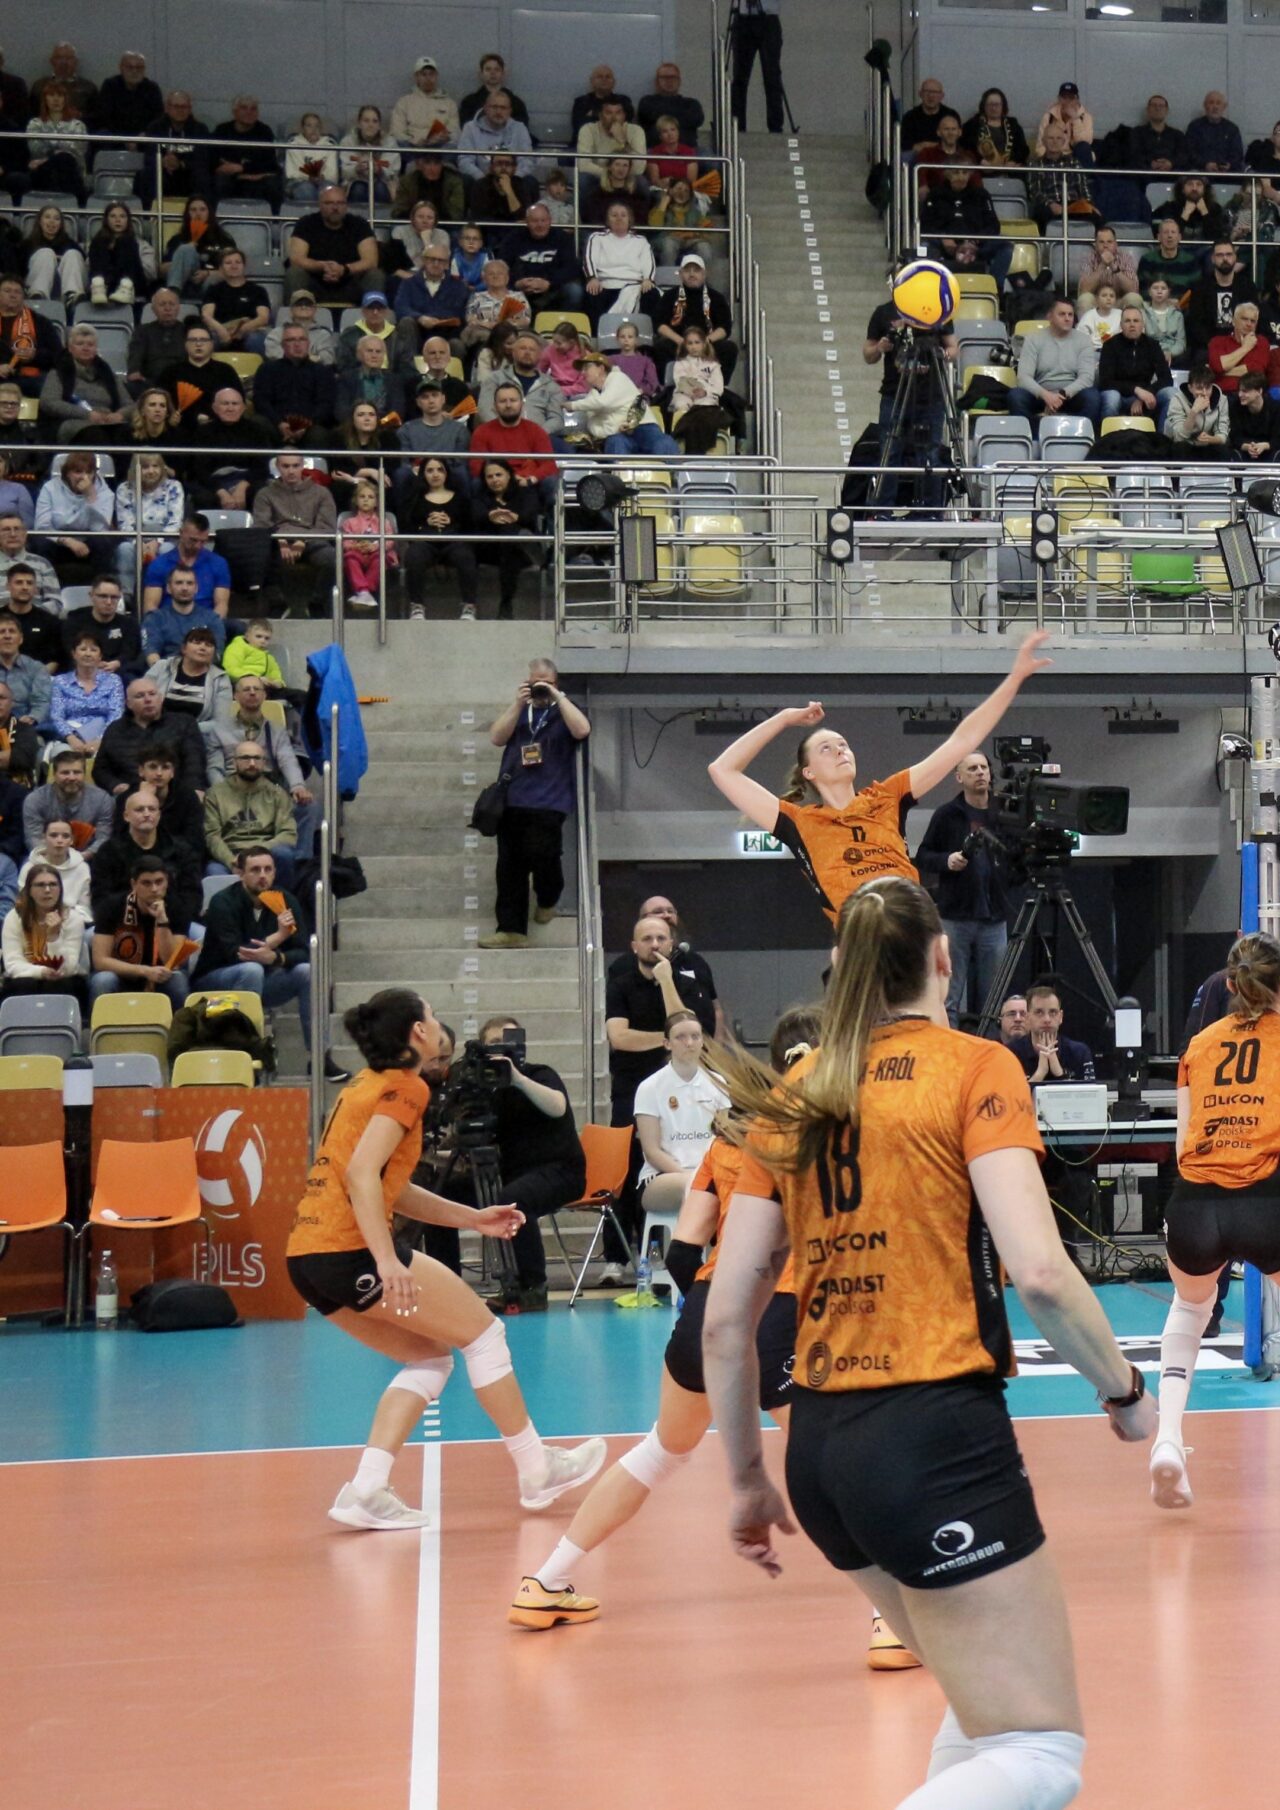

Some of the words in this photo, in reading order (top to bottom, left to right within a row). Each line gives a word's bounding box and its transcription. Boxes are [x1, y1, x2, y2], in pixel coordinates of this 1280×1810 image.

[863, 846, 894, 858] OPOL
[1214, 1037, 1261, 1087] 20
[1218, 1093, 1265, 1106] LICON
[1215, 1139, 1252, 1149] OPOLE
[816, 1113, 863, 1219] 18
[193, 1242, 266, 1288] PLS
[828, 1274, 886, 1296] ADAST
[835, 1353, 892, 1373] OPOLE
